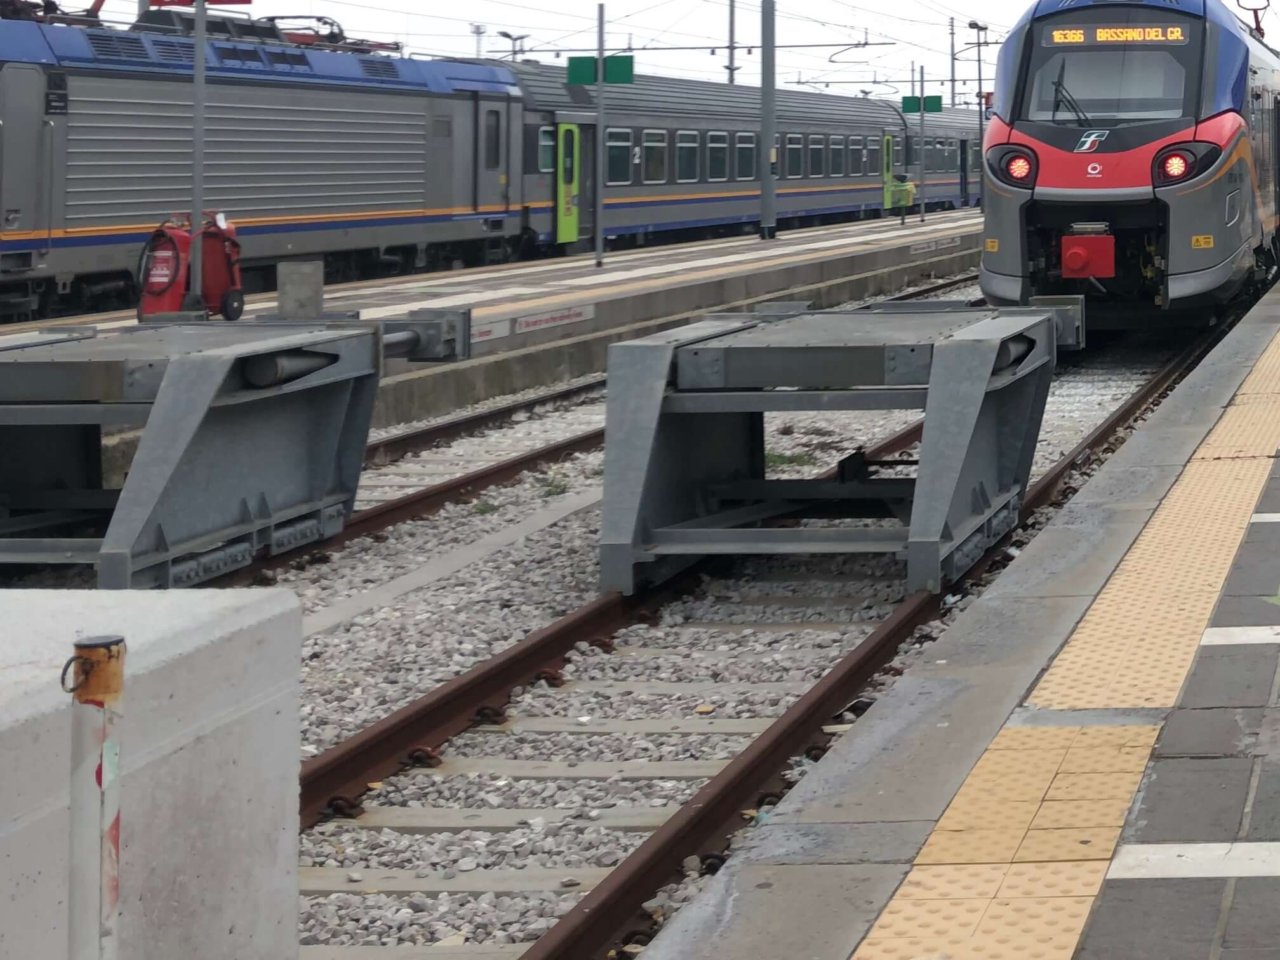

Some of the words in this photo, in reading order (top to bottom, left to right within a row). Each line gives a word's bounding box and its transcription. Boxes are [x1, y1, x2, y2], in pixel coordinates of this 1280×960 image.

[1052, 30, 1085, 43] 16366
[1096, 28, 1144, 41] BASSANO
[1145, 28, 1165, 40] DEL
[1167, 27, 1184, 40] GR.
[632, 146, 641, 164] 2
